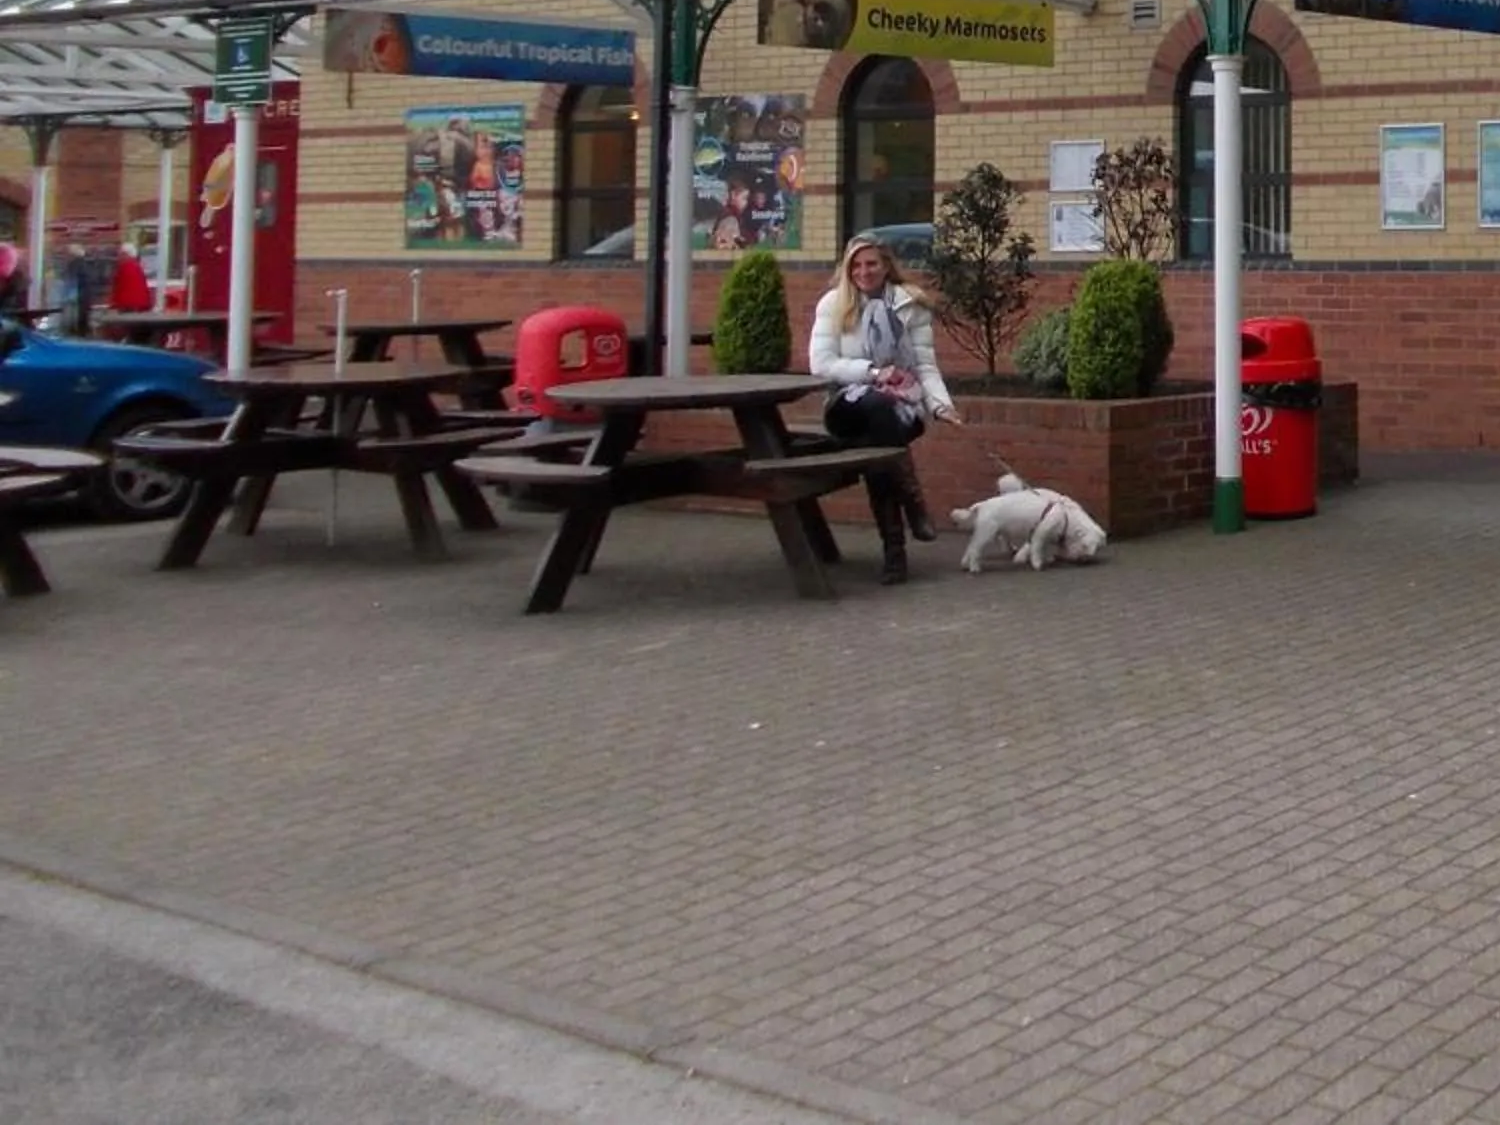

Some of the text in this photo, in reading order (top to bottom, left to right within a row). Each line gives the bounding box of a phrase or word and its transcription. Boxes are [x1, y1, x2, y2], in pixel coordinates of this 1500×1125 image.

[867, 7, 940, 38] Cheeky
[418, 35, 633, 66] Colourful Tropical Fish
